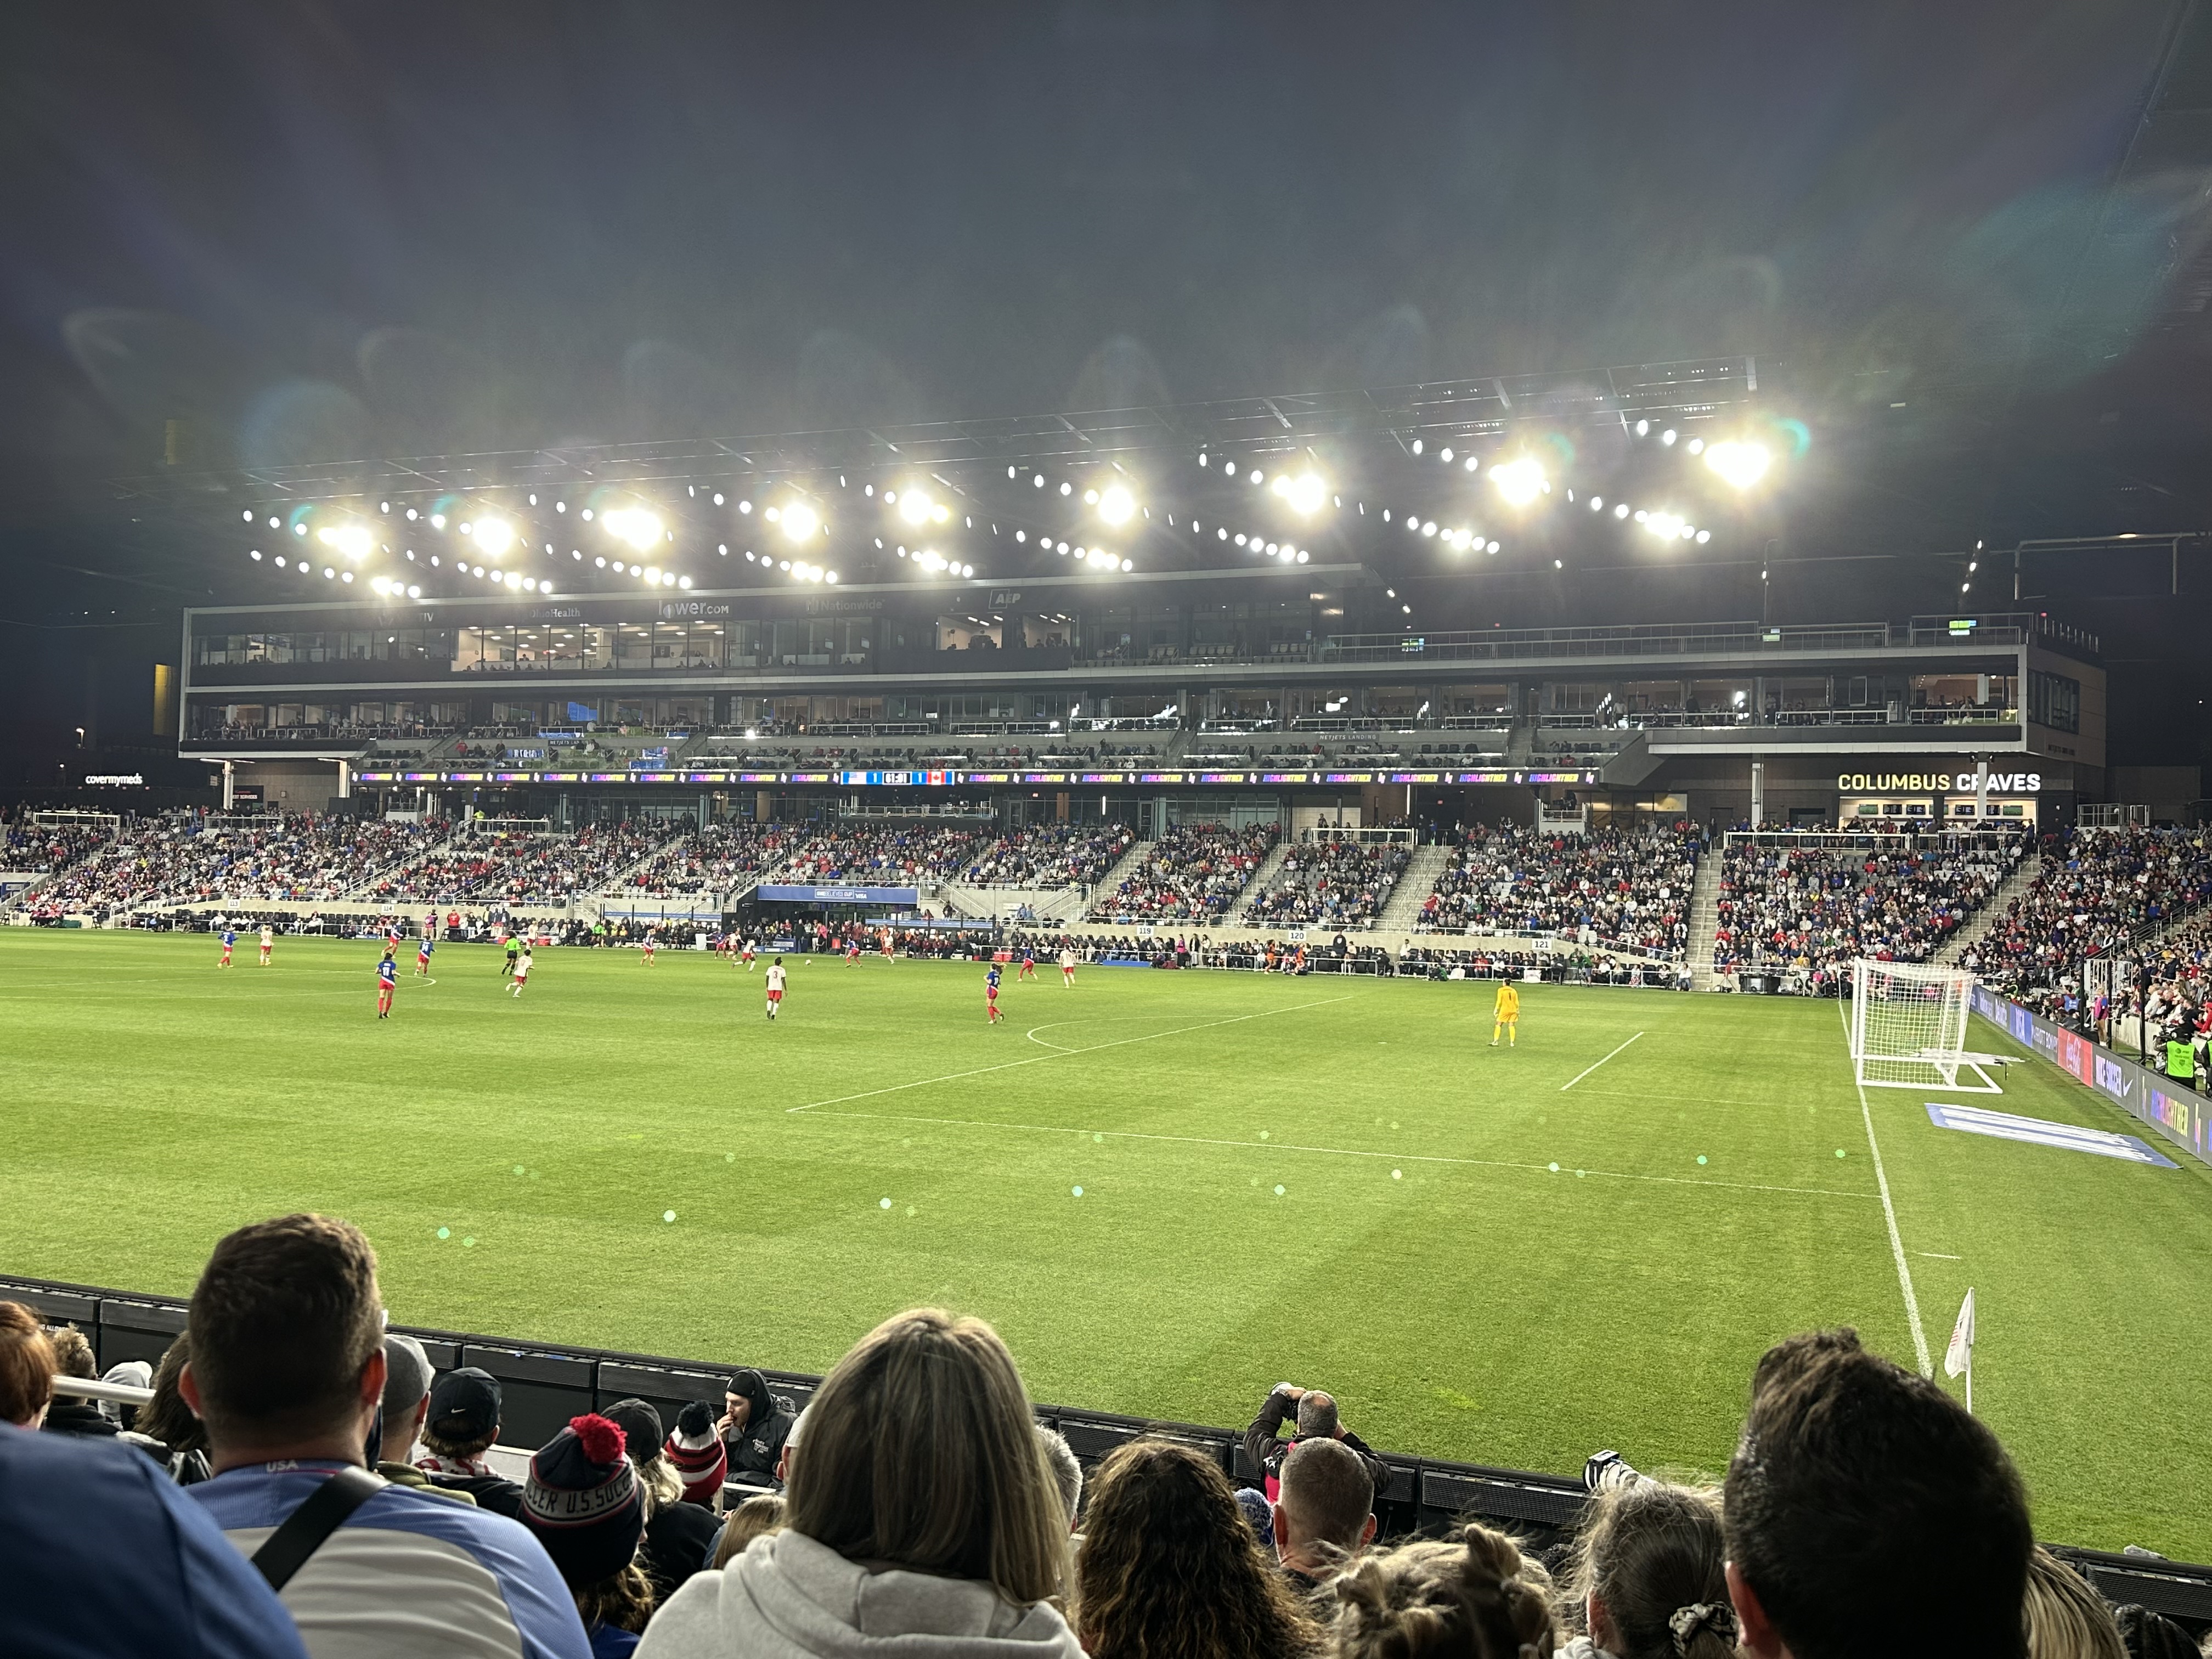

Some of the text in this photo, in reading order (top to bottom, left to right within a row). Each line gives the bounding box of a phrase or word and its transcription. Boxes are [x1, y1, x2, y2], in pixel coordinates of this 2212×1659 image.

[995, 593, 1020, 603] AEP
[86, 773, 143, 787] covermymeds
[1838, 774, 1950, 791] COLUMBUS
[2106, 1059, 2122, 1098] SOCCER
[267, 1459, 299, 1472] USA
